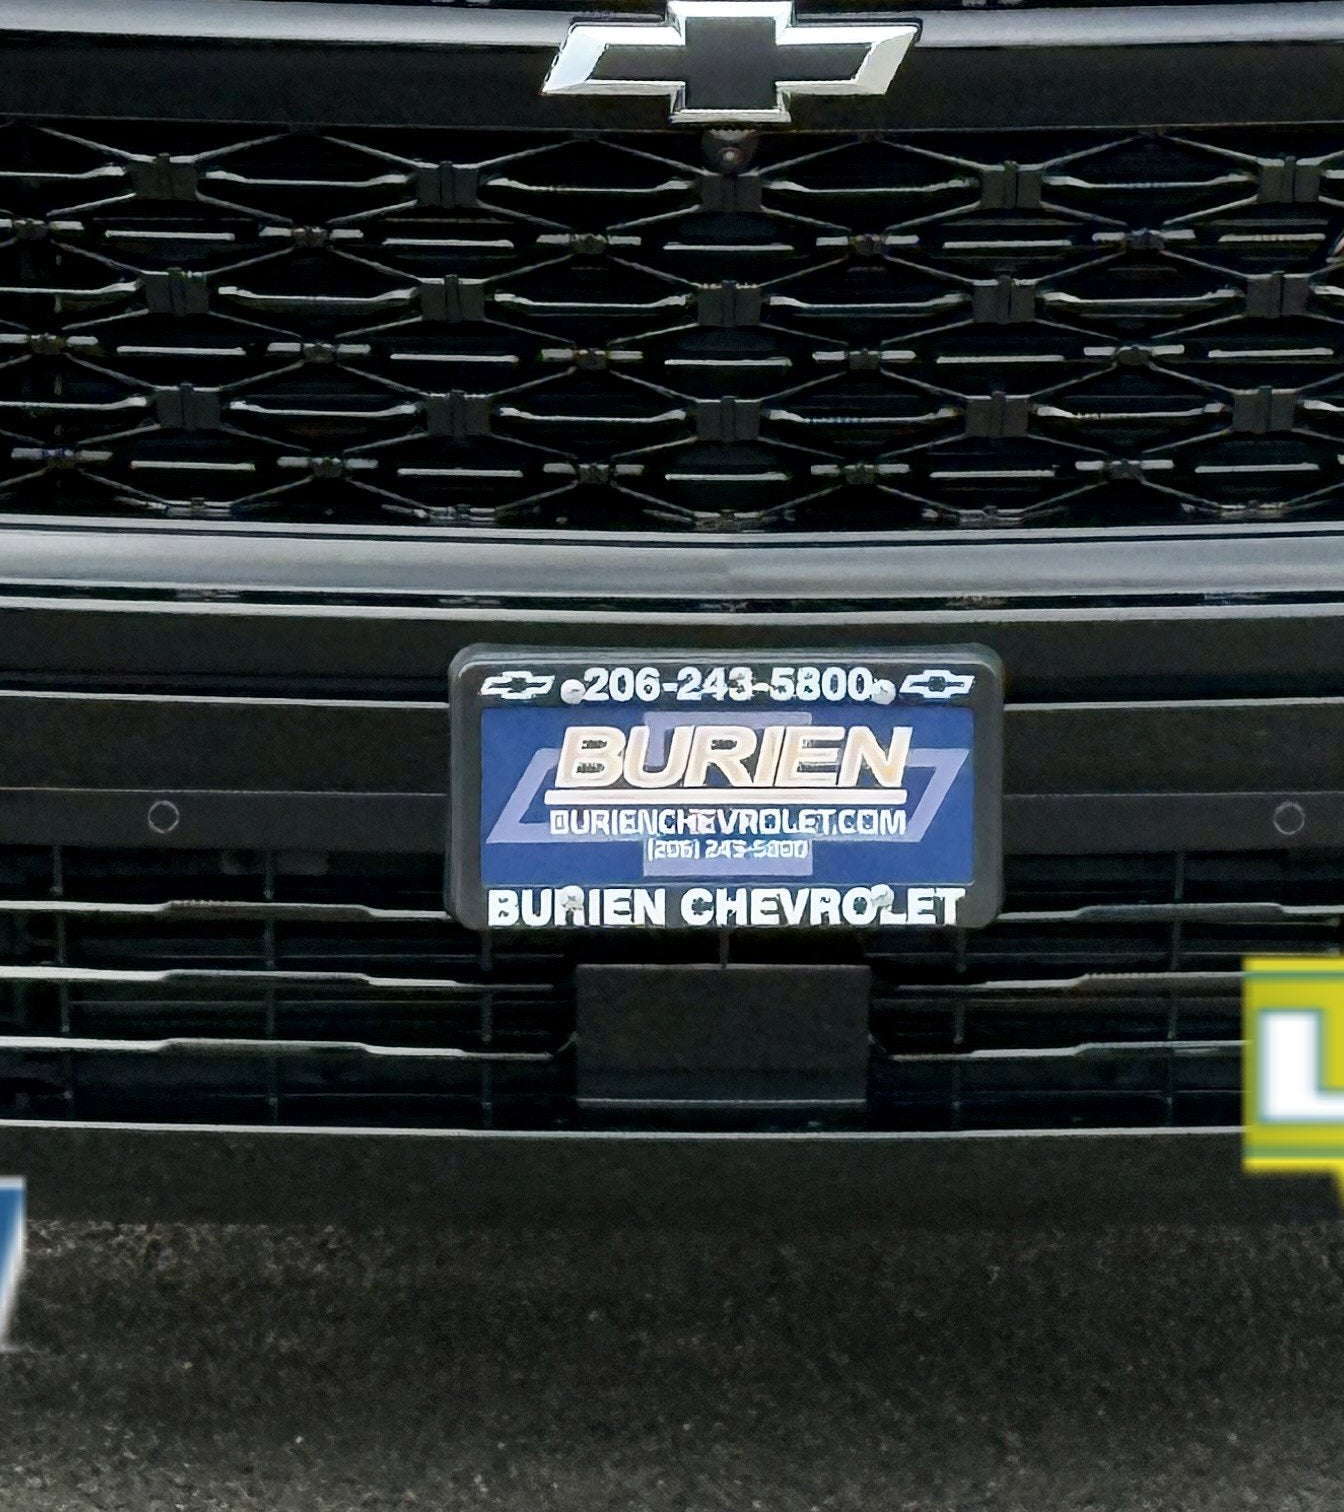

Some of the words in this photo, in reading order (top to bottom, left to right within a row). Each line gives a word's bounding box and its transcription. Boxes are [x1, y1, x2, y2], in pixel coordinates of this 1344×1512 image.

[582, 666, 873, 702] 206-243-5800
[555, 725, 912, 790] BURIEN
[487, 888, 667, 928] BURIEN
[680, 886, 966, 928] CHEVROLET
